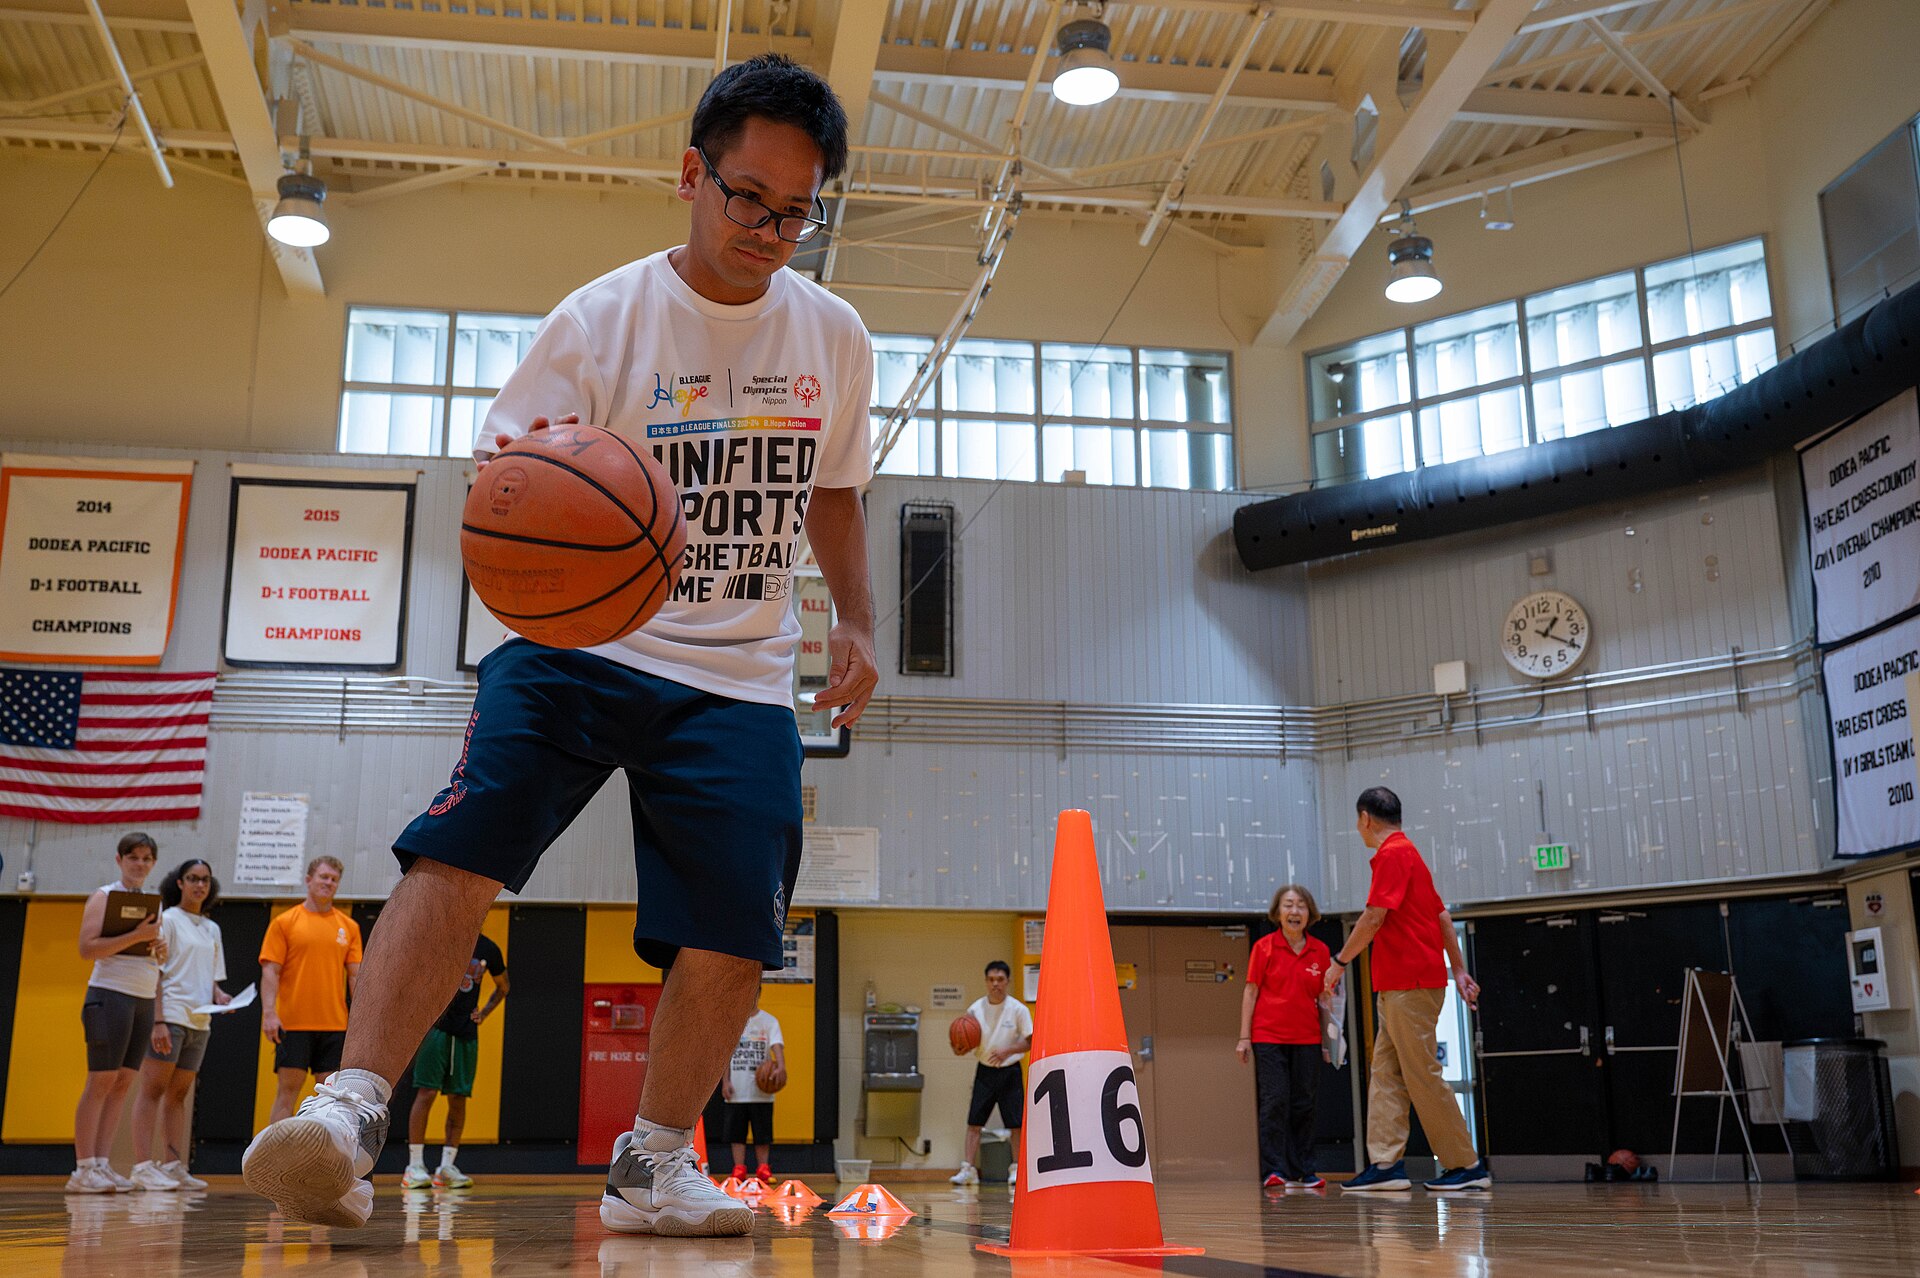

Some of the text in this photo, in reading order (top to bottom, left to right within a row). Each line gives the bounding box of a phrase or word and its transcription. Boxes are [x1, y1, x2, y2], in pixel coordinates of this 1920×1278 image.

[679, 375, 712, 385] B.LEAGUE
[752, 376, 788, 384] Special
[646, 371, 709, 418] Hope
[742, 386, 788, 394] Olympics
[762, 396, 788, 405] Nippon
[652, 427, 678, 436] 日本生命
[680, 422, 712, 432] B.LEAGUE
[712, 420, 736, 430] FINALS
[1830, 435, 1891, 488] DODEA PACIFIC
[1827, 499, 1850, 527] EAST
[1852, 482, 1878, 514] CROSS
[1878, 460, 1916, 497] COUNTRY
[77, 501, 112, 512] 2014
[680, 490, 808, 536] PORTS
[304, 510, 340, 522] 2015
[29, 538, 150, 554] DODEA PACIFIC
[1836, 528, 1871, 562] OVERALL
[260, 547, 378, 562] DODEA PACIFIC
[30, 578, 142, 594] D-1 FOOTBALL
[669, 576, 714, 602] ME
[262, 586, 370, 602] D-1 FOOTBALL
[1523, 605, 1535, 618] 11
[1538, 600, 1550, 614] 12
[1556, 602, 1560, 613] 1
[1566, 610, 1574, 621] 2
[32, 620, 132, 634] CHAMPIONS
[1510, 618, 1526, 631] 10
[1570, 623, 1579, 635] 3
[266, 627, 361, 641] CHAMPIONS
[1512, 633, 1521, 646] 9
[1518, 645, 1527, 657] 8
[1558, 650, 1566, 662] 5
[1530, 654, 1538, 666] 7
[1543, 656, 1552, 668] 6
[1884, 650, 1919, 681] PACIFIC
[1835, 699, 1907, 739] AR EAST CROSS
[1860, 748, 1884, 772] GIRLS
[1885, 739, 1909, 765] TEAM
[1888, 782, 1914, 806] 2010
[1538, 846, 1564, 868] EXIT
[740, 1042, 766, 1050] NIFIED
[733, 1051, 765, 1060] SPORTS
[1034, 1066, 1146, 1174] 16
